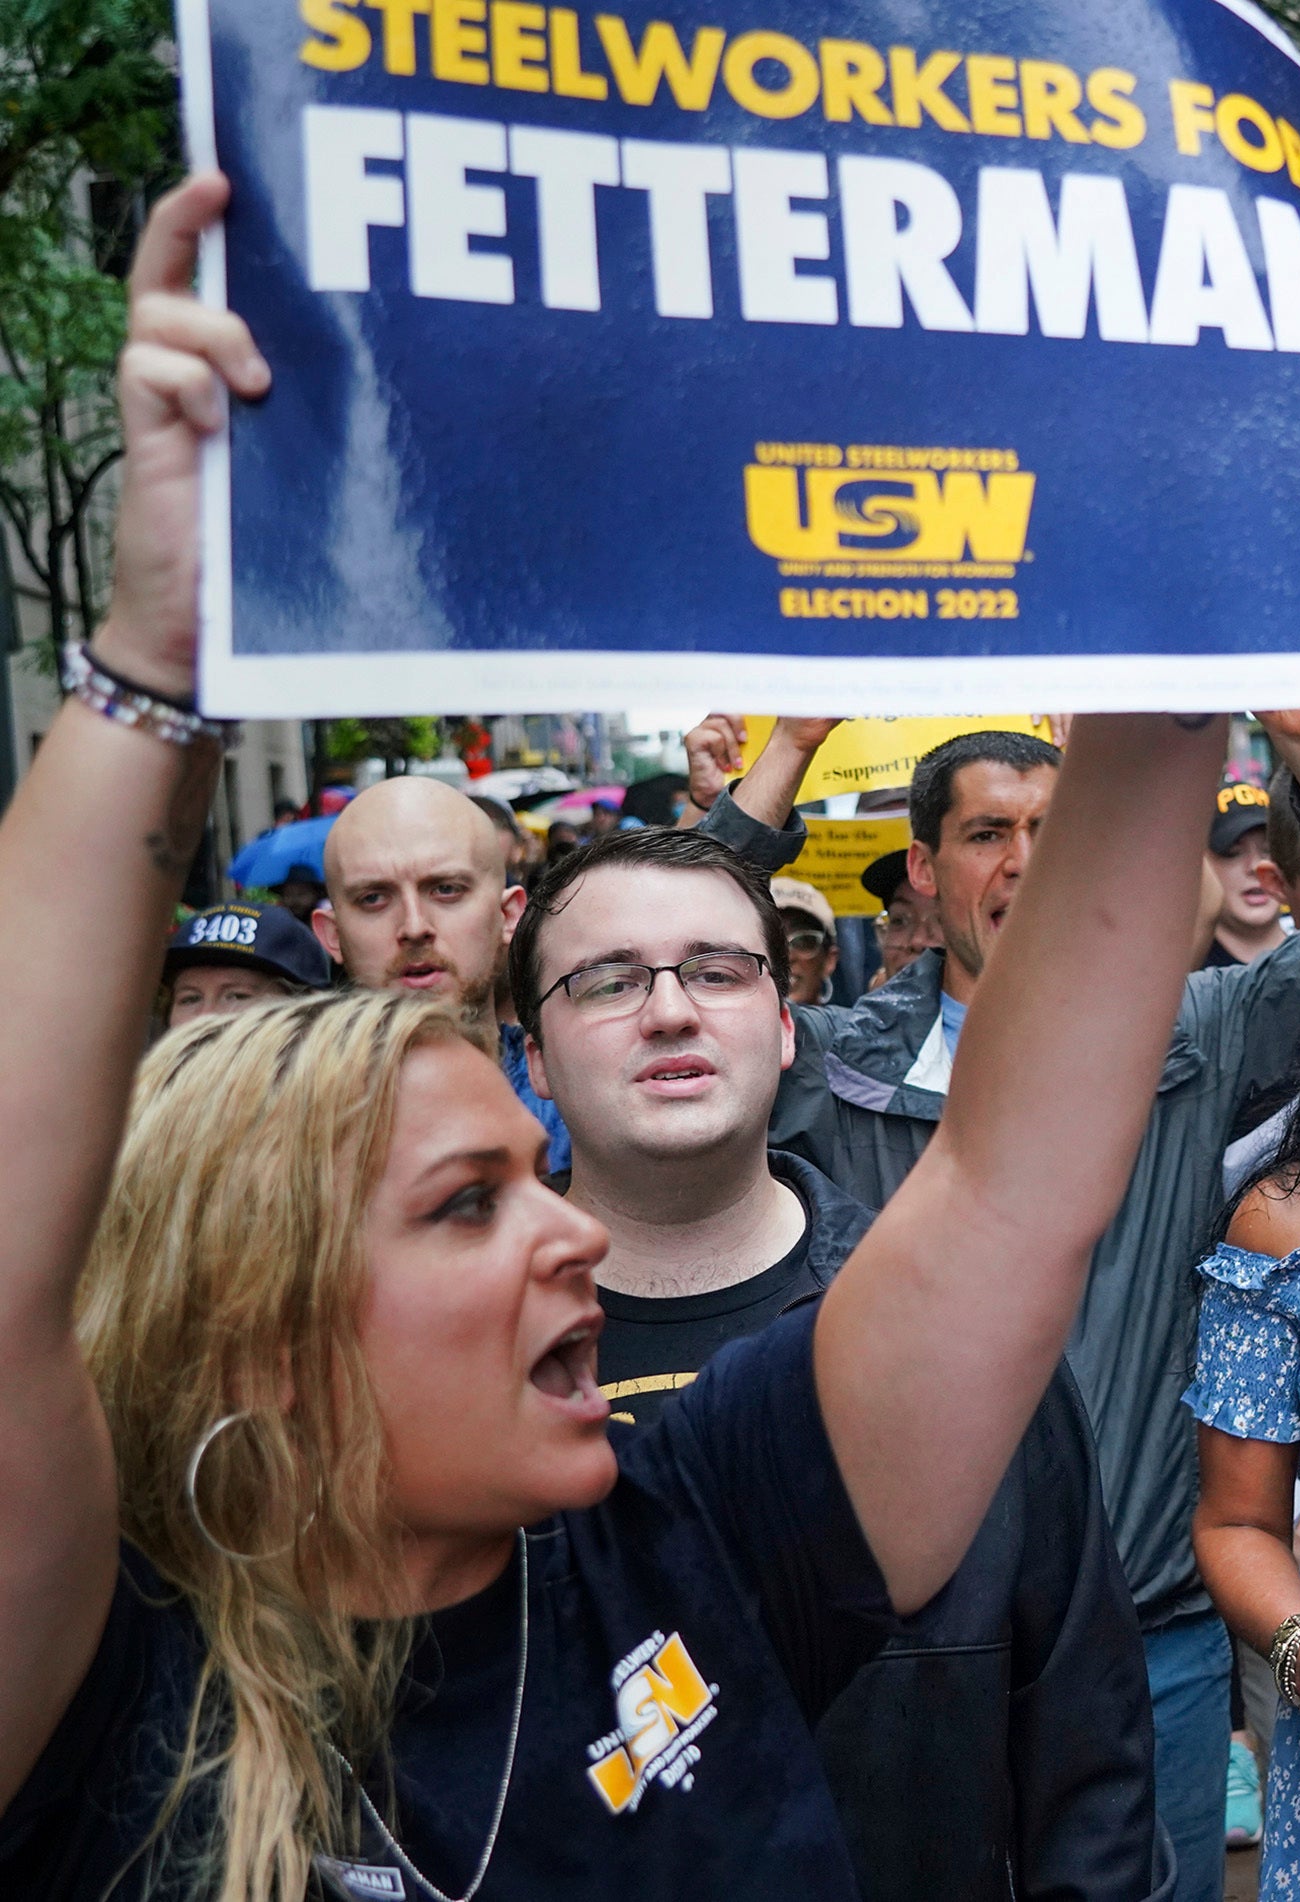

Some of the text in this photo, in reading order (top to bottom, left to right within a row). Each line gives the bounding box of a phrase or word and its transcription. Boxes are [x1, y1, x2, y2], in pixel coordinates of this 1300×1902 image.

[299, 0, 1146, 150] STEELWORKERS
[755, 442, 1019, 472] UNITED STEELWORKERS
[780, 587, 1020, 620] ELECTION 2022
[188, 914, 258, 945] 3403
